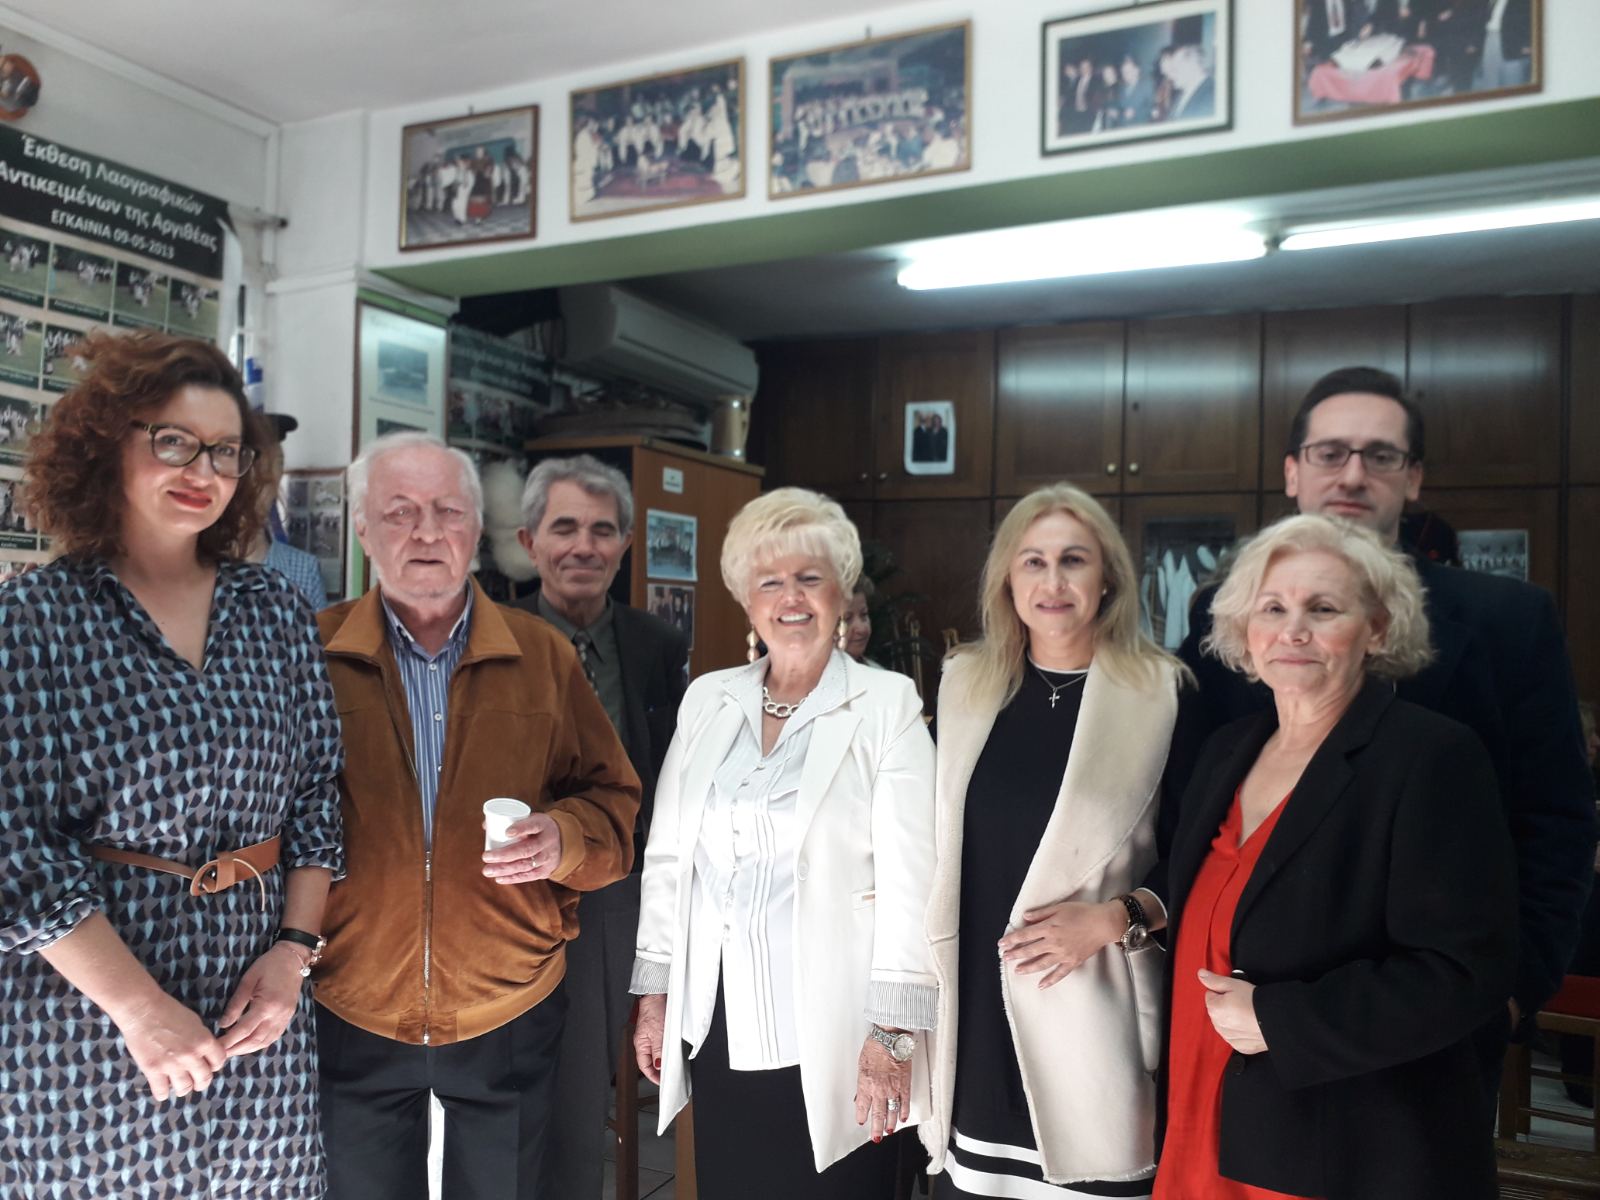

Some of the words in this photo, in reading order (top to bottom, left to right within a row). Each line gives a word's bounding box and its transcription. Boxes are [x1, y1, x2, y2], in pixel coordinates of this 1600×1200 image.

[0, 160, 121, 214] Αντικειμένων
[124, 206, 149, 229] της
[152, 212, 218, 252] Αργιθέας
[21, 134, 91, 179] Έκθεση
[95, 162, 203, 215] Λαογραφικών
[51, 208, 111, 240] ΕΓΚΑΙΝΙΑ
